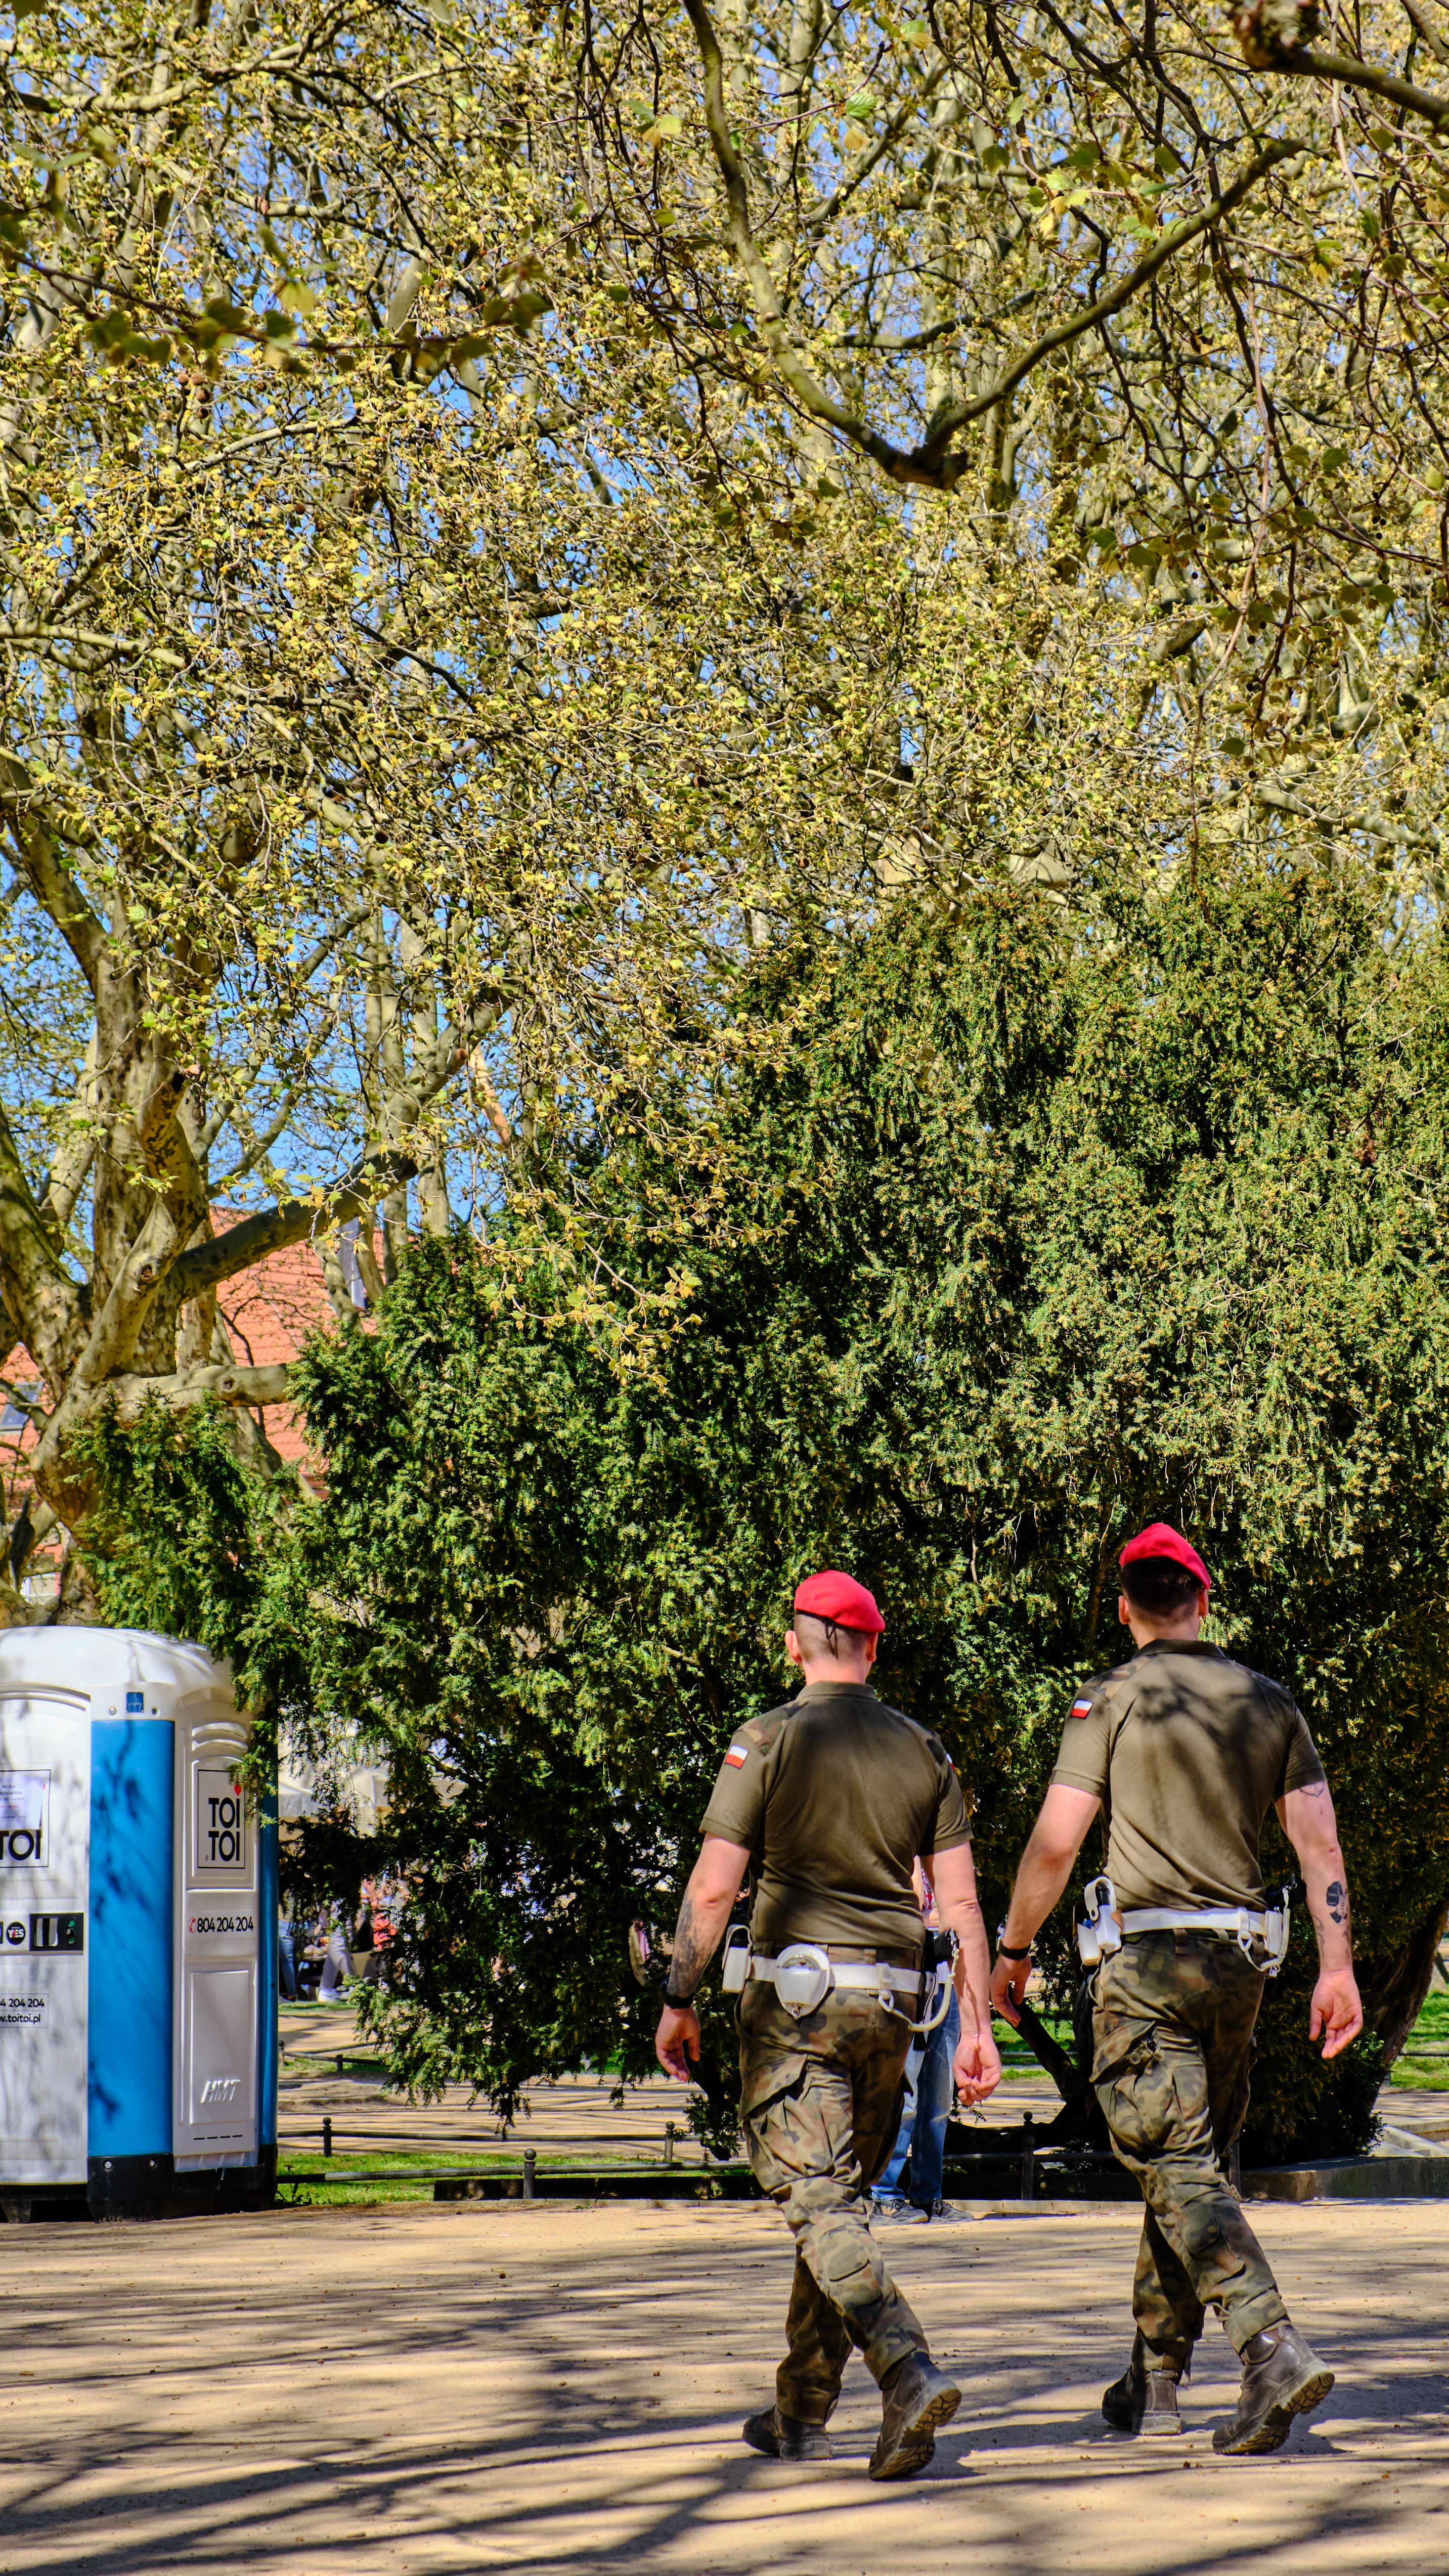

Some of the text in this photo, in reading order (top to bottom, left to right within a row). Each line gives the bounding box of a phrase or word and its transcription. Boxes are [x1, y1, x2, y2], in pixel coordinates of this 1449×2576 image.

[208, 1797, 240, 1828] TOI
[208, 1830, 240, 1862] TOI
[197, 1916, 254, 1933] 804 204 204
[8, 1998, 26, 2007] 204
[28, 1998, 45, 2007] 204
[201, 2079, 241, 2103] HMT
